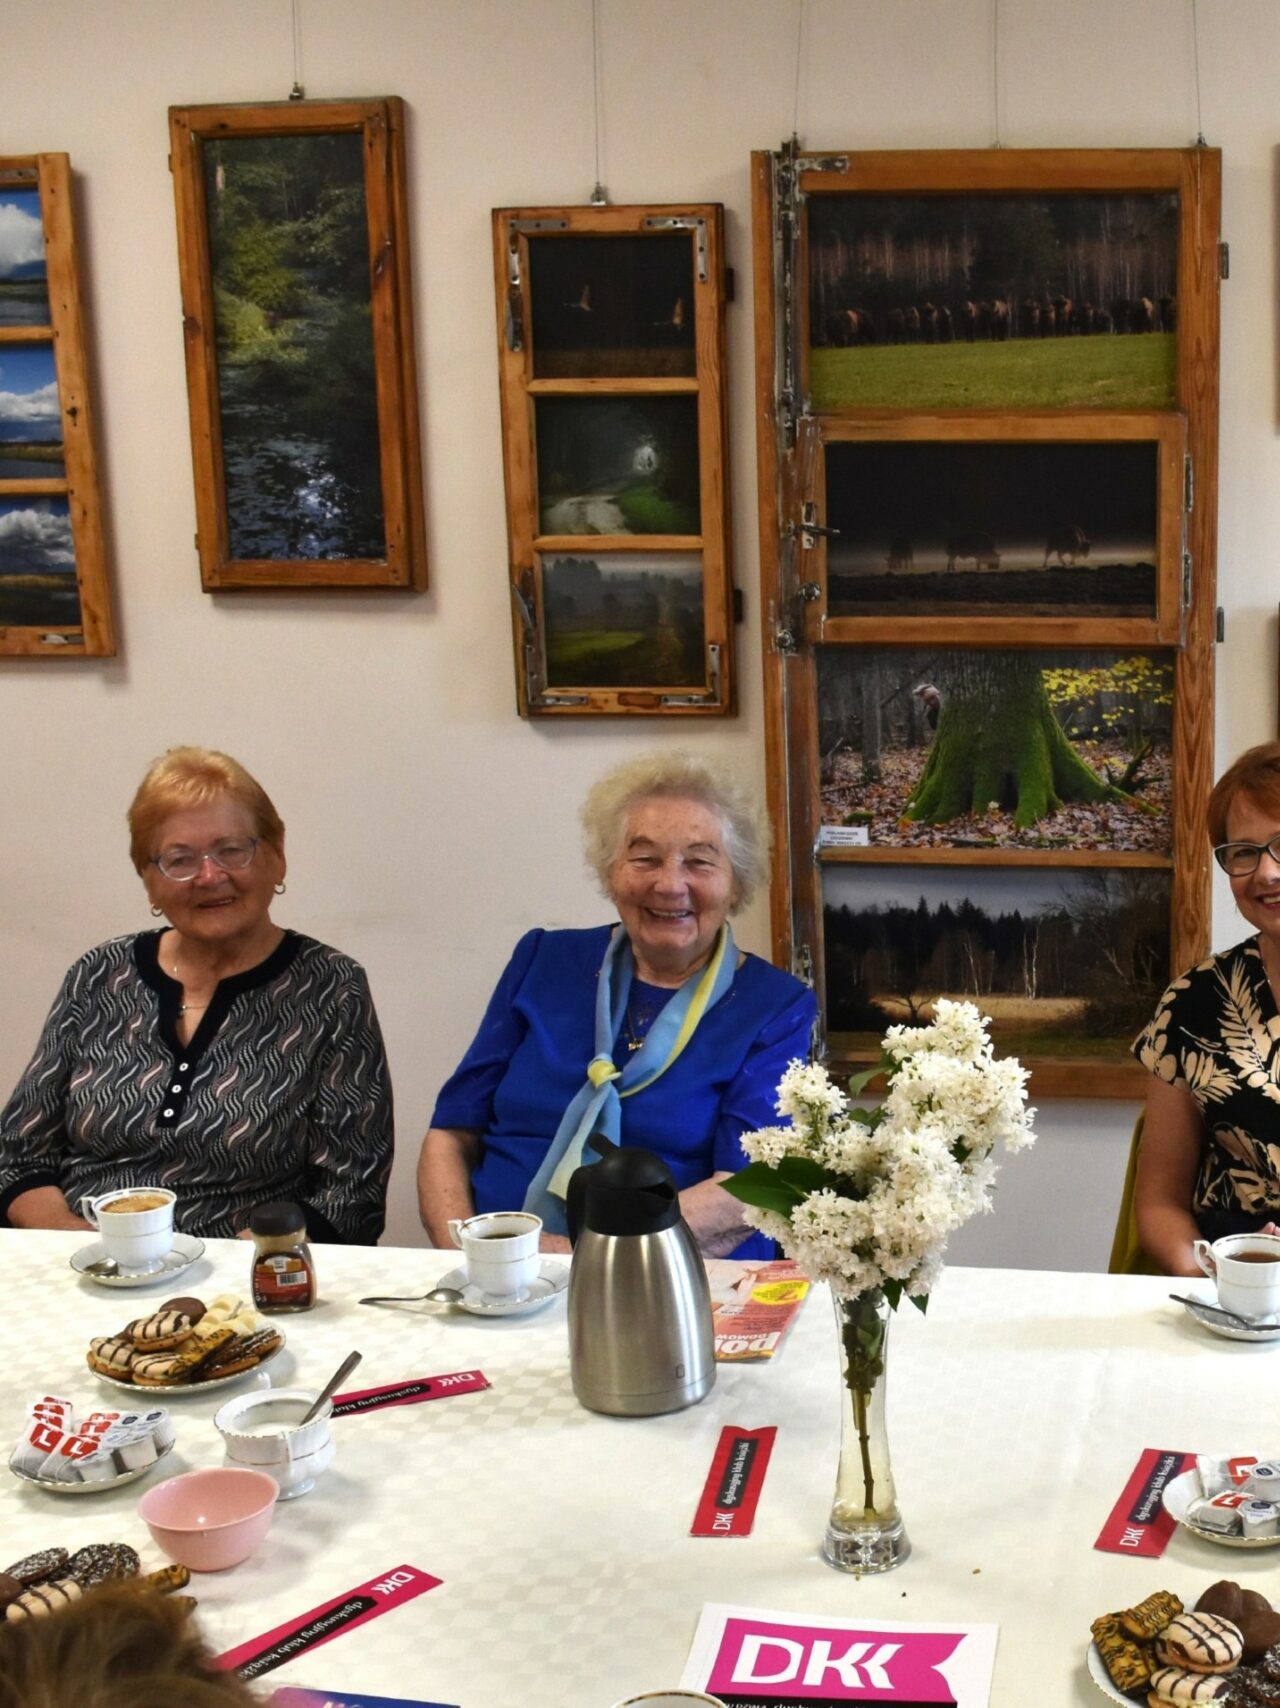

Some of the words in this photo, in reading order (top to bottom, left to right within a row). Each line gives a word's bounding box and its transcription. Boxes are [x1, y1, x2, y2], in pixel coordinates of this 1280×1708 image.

[715, 1331, 781, 1354] po
[358, 1386, 421, 1408] dyskusyjny
[731, 1460, 744, 1473] klub
[1157, 1455, 1175, 1476] książki
[722, 1473, 743, 1505] dyskusyjny
[1151, 1475, 1167, 1489] klub
[1136, 1489, 1162, 1521] dyskusyjny
[302, 1600, 363, 1640] dyskusyjny
[277, 1635, 306, 1655] klub
[236, 1652, 281, 1680] książki
